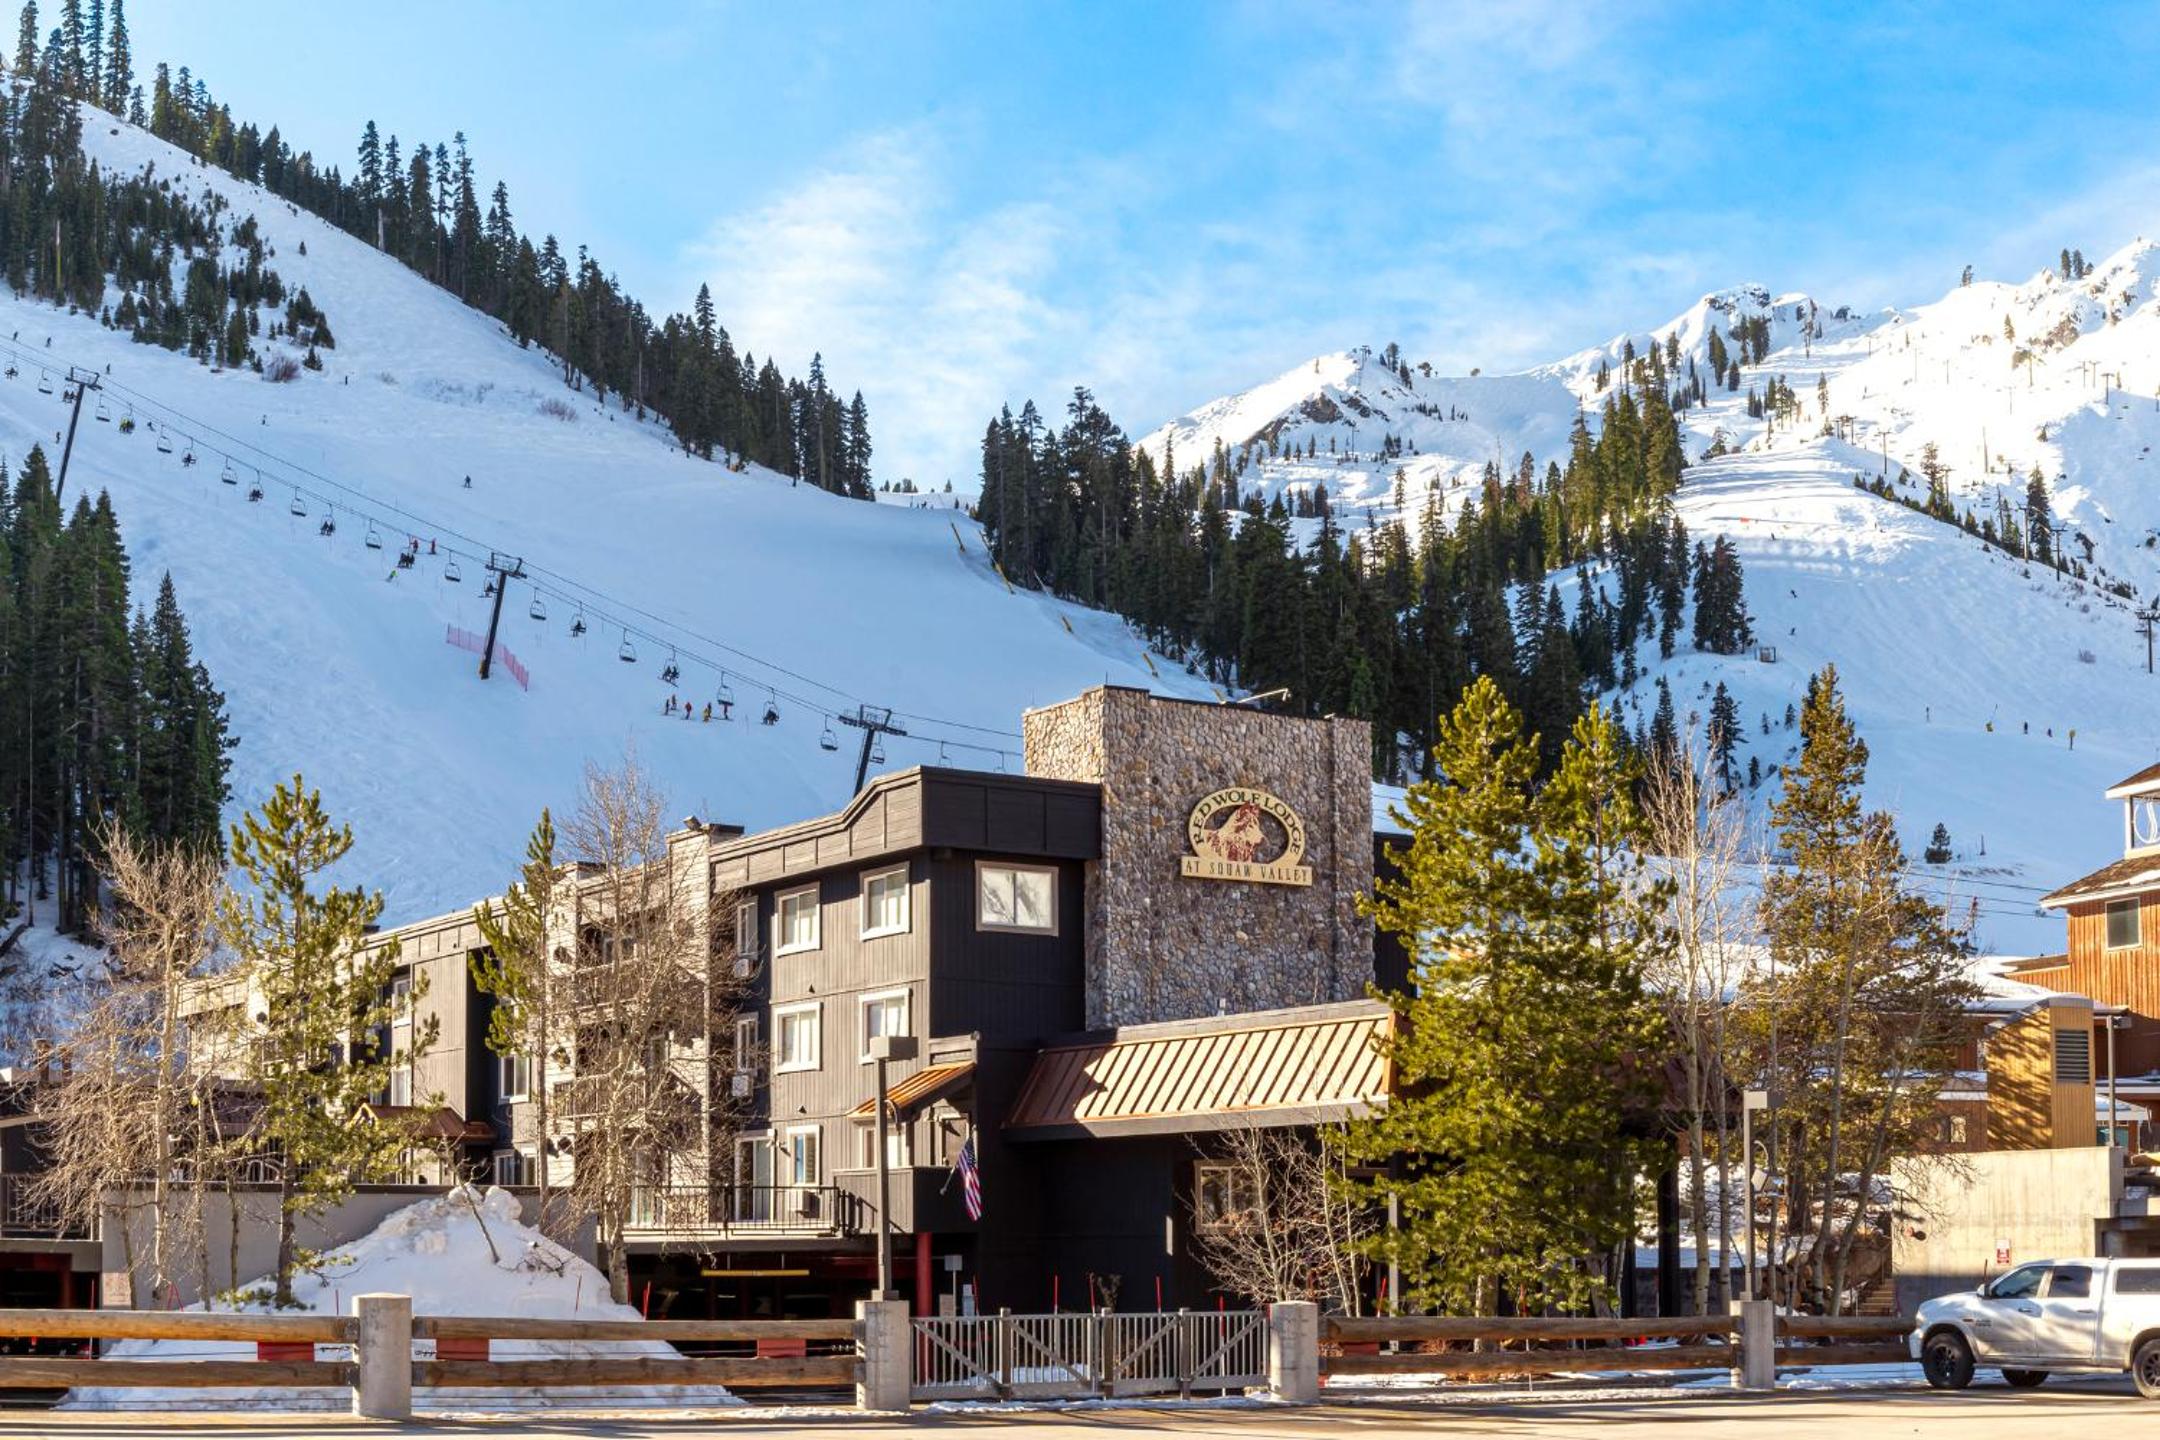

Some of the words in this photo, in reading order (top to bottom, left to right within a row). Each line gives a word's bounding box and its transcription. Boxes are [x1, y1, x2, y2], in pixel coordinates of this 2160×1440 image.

[1193, 802, 1212, 845] RED
[1211, 790, 1261, 806] WOLF
[1264, 797, 1302, 855] LODGE
[1186, 860, 1200, 873] AT
[1209, 862, 1251, 877] SQUAW
[1260, 866, 1308, 882] VALLEY
